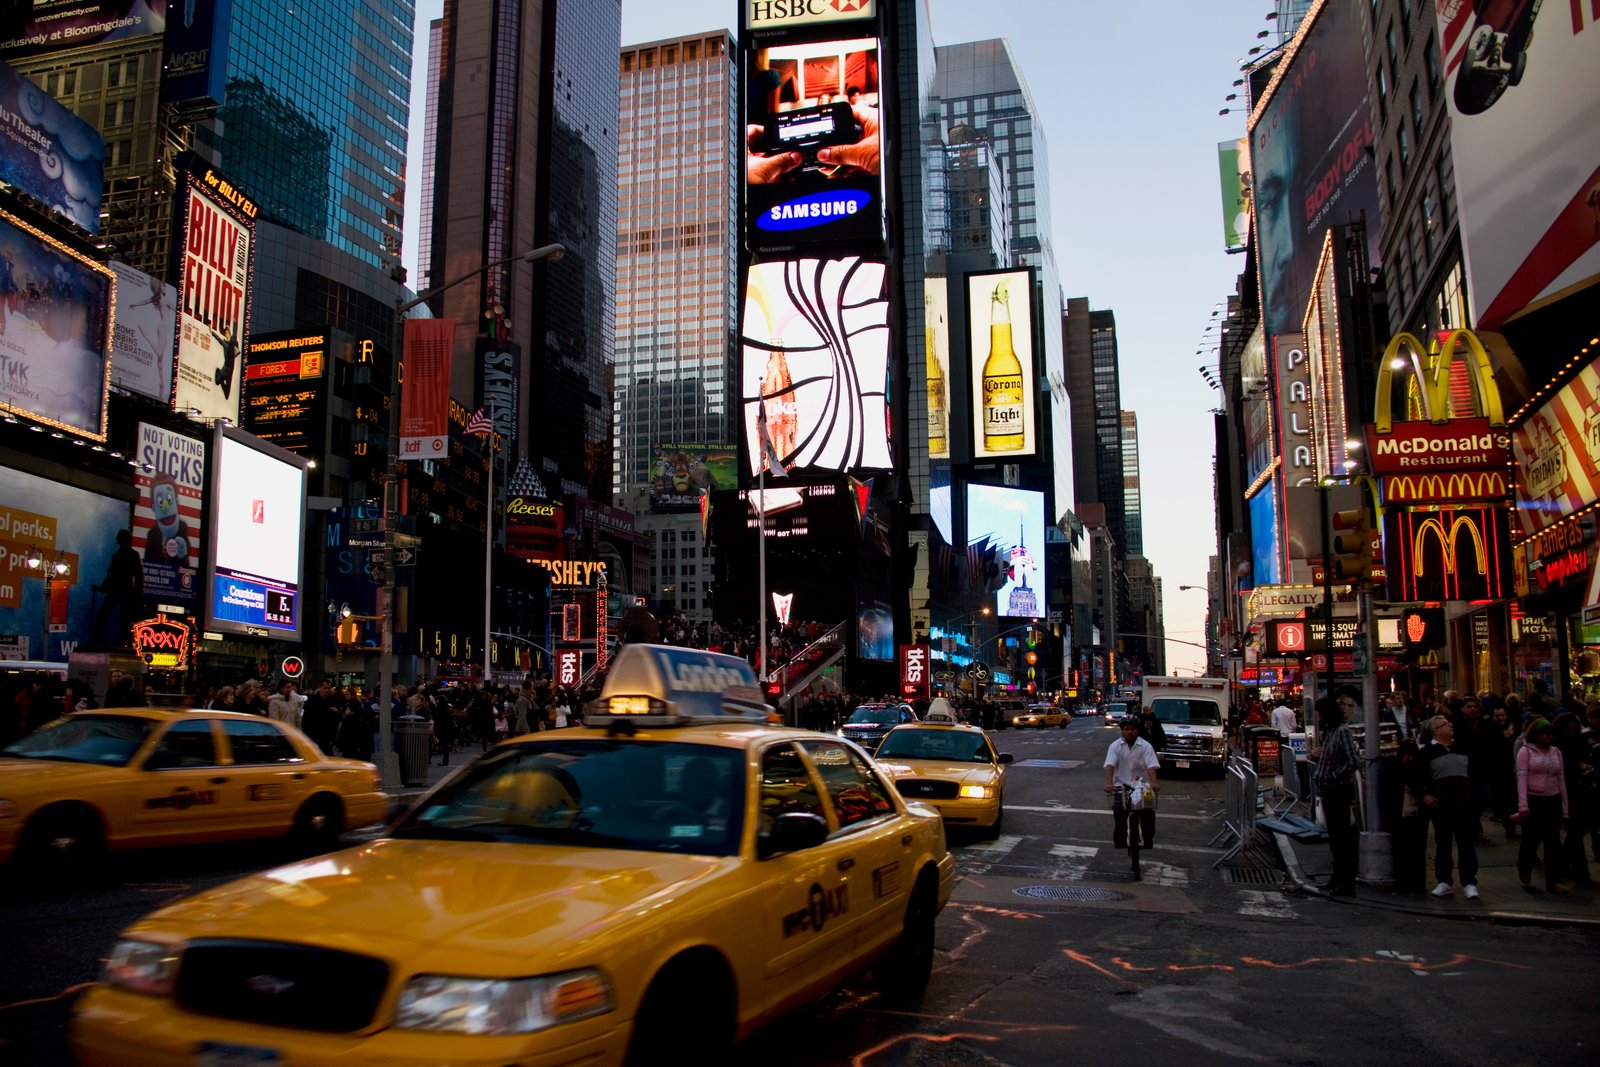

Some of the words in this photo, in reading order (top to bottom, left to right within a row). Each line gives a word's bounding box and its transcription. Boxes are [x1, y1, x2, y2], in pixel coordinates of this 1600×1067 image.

[35, 5, 100, 23] uncoverthecity.com
[752, 0, 826, 21] HSBC
[51, 30, 62, 41] at
[65, 16, 142, 38] Bloomingdale's
[10, 112, 52, 150] Theater
[1305, 155, 1342, 222] BODY
[1343, 128, 1363, 173] OF
[204, 170, 219, 188] for
[218, 180, 246, 207] BILLY
[243, 200, 258, 218] ELI
[770, 200, 858, 220] SAMSUNG
[188, 195, 239, 280] BILLY
[184, 256, 242, 340] ELLIOT
[251, 340, 288, 353] THOMSON
[289, 336, 324, 348] REUTERS
[260, 364, 286, 376] FOREX
[985, 379, 1021, 394] Corona
[989, 406, 1019, 424] Light
[144, 427, 165, 445] NOT
[168, 434, 202, 457] VOTING
[406, 440, 421, 452] tdf
[1377, 433, 1508, 455] McDonald's
[144, 445, 202, 487] SUCKS
[1400, 453, 1488, 467] Restaurant
[506, 498, 555, 517] Reese's
[12, 518, 53, 541] perks.
[349, 539, 372, 548] Morgan
[230, 585, 264, 602] Countdown
[1264, 594, 1318, 606] LEGALLY
[139, 626, 182, 649] ROXY
[490, 641, 542, 670] B'WY
[908, 648, 925, 683] tkts
[284, 662, 300, 673] W
[562, 652, 576, 684] tkts
[658, 652, 746, 693] London
